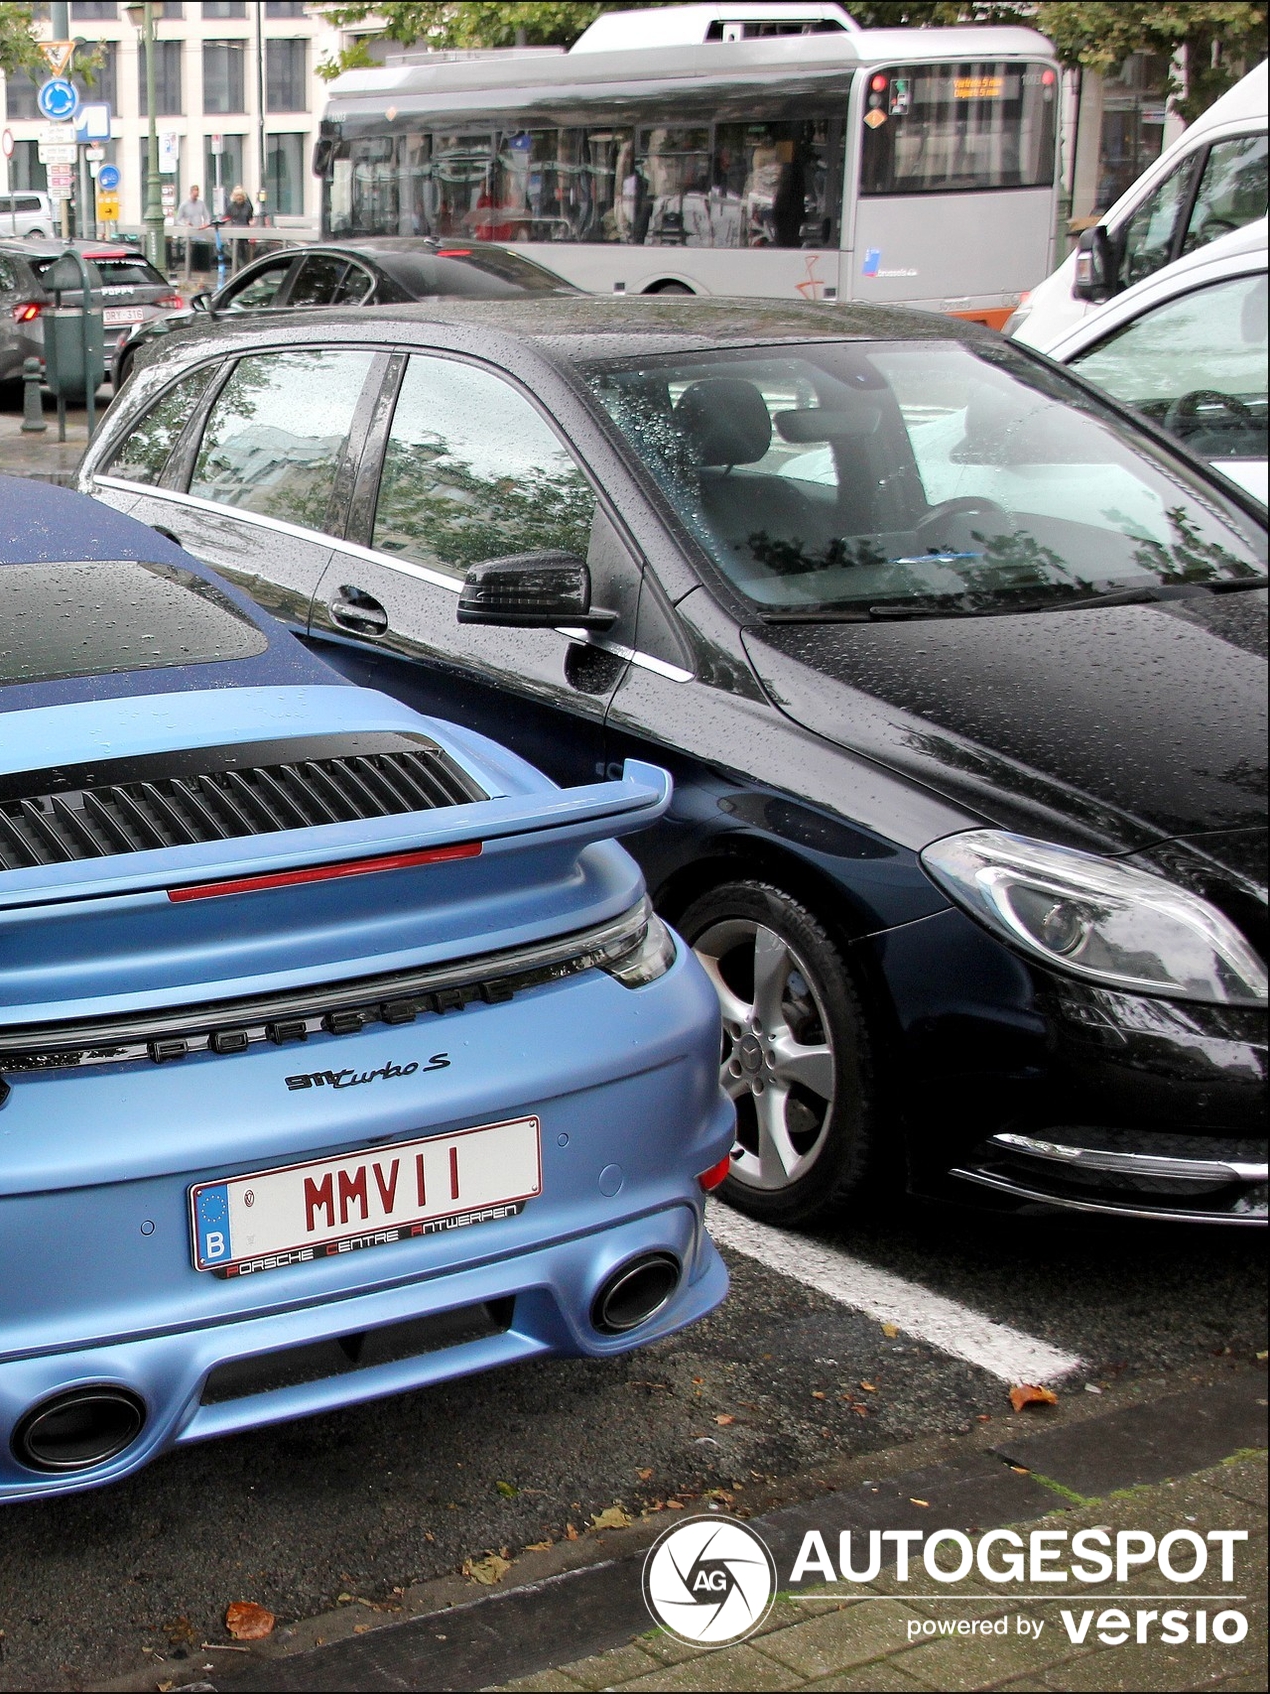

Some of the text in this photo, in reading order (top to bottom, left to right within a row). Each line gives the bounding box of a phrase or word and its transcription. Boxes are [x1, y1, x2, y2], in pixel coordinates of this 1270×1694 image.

[423, 1053, 451, 1072] S
[303, 1147, 459, 1232] MMVII
[205, 1232, 225, 1259] B
[226, 1204, 517, 1278] PORSCHE CENTRE ANTWERPEN
